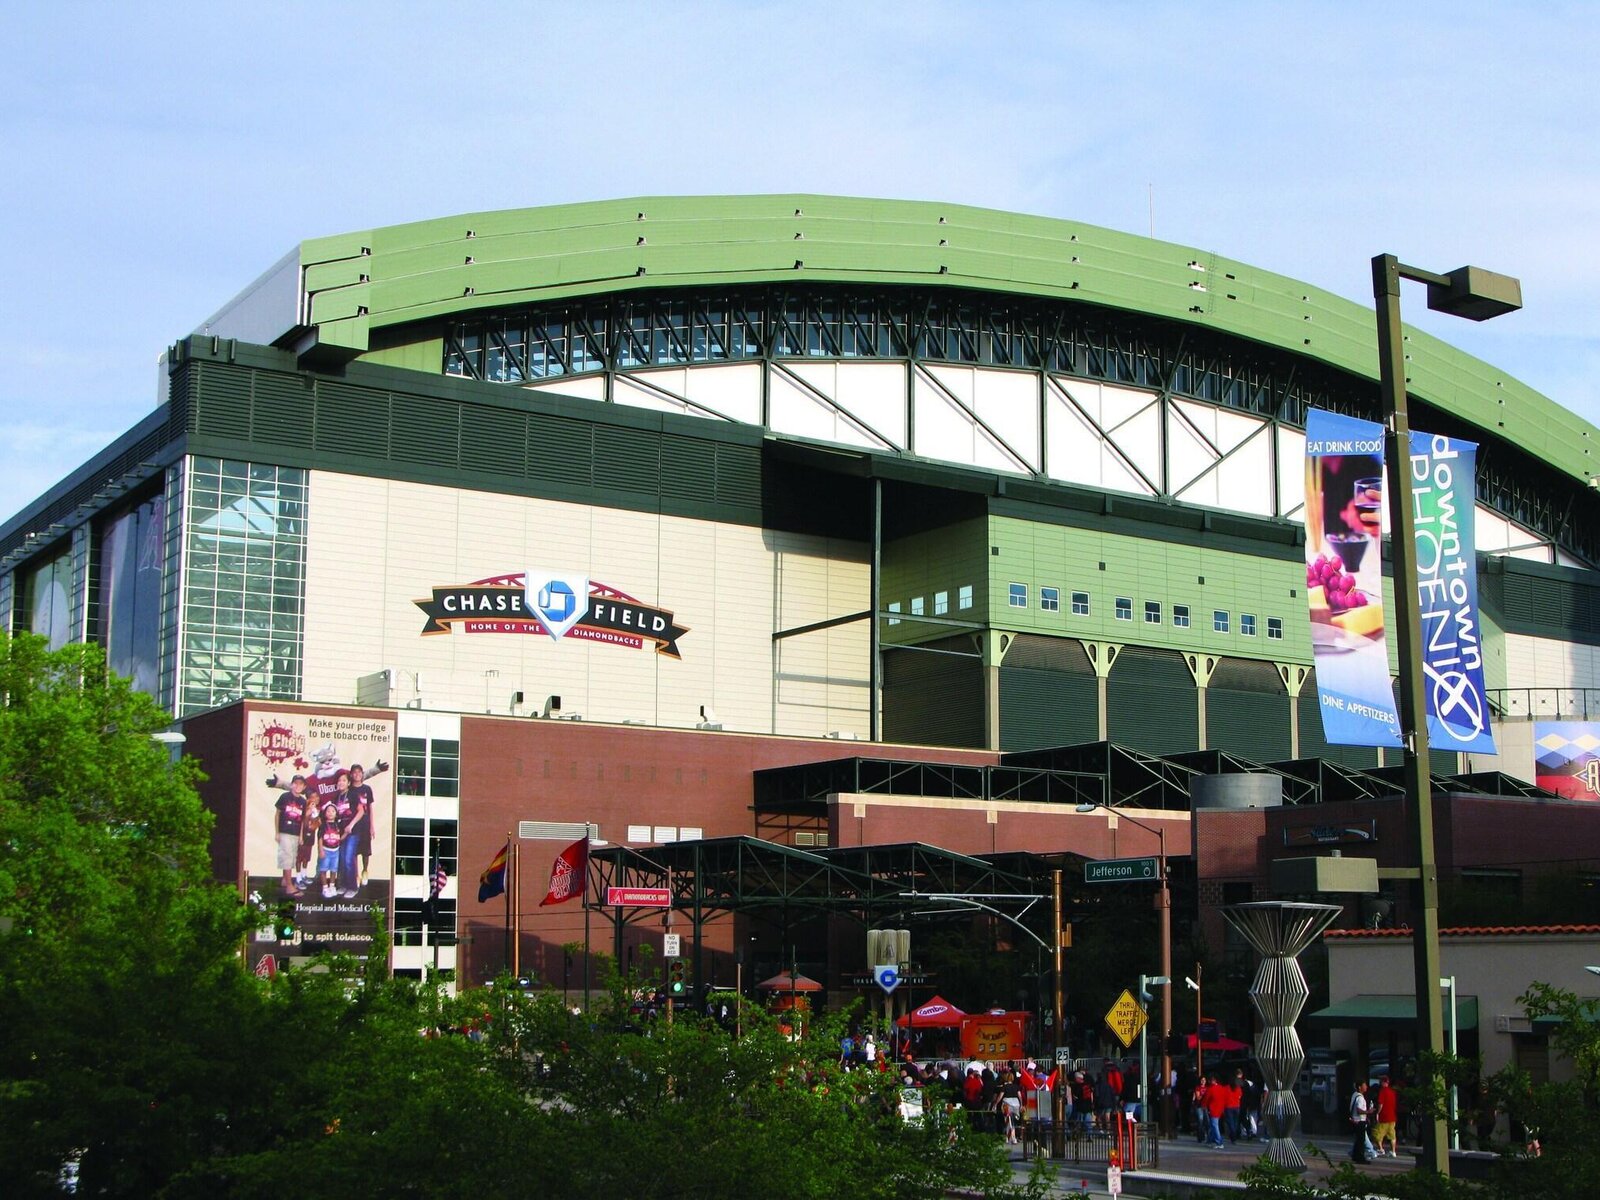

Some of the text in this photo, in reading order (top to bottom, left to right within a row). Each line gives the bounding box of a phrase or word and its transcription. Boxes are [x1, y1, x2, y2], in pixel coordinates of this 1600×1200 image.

[1307, 440, 1382, 453] EAT DRINK FOOD
[1431, 434, 1481, 670] downtown
[443, 594, 666, 632] CHASE FIELD
[522, 624, 540, 632] THE
[573, 629, 640, 646] DIAMONDBACKS
[1322, 694, 1395, 725] DINE APPETIZERS
[308, 718, 387, 733] Make your pledge
[308, 729, 390, 743] to be tobacco free!
[1092, 866, 1132, 877] Jefferson
[295, 903, 324, 914] Hospital
[324, 903, 337, 912] and
[337, 903, 363, 912] Medical
[303, 932, 313, 941] to
[315, 932, 333, 942] spit
[335, 932, 374, 942] tobacco.
[1119, 1001, 1136, 1009] THRU
[1116, 1010, 1139, 1018] TRAFFIC
[1120, 1027, 1135, 1035] LEFT
[1057, 1050, 1068, 1061] 25
